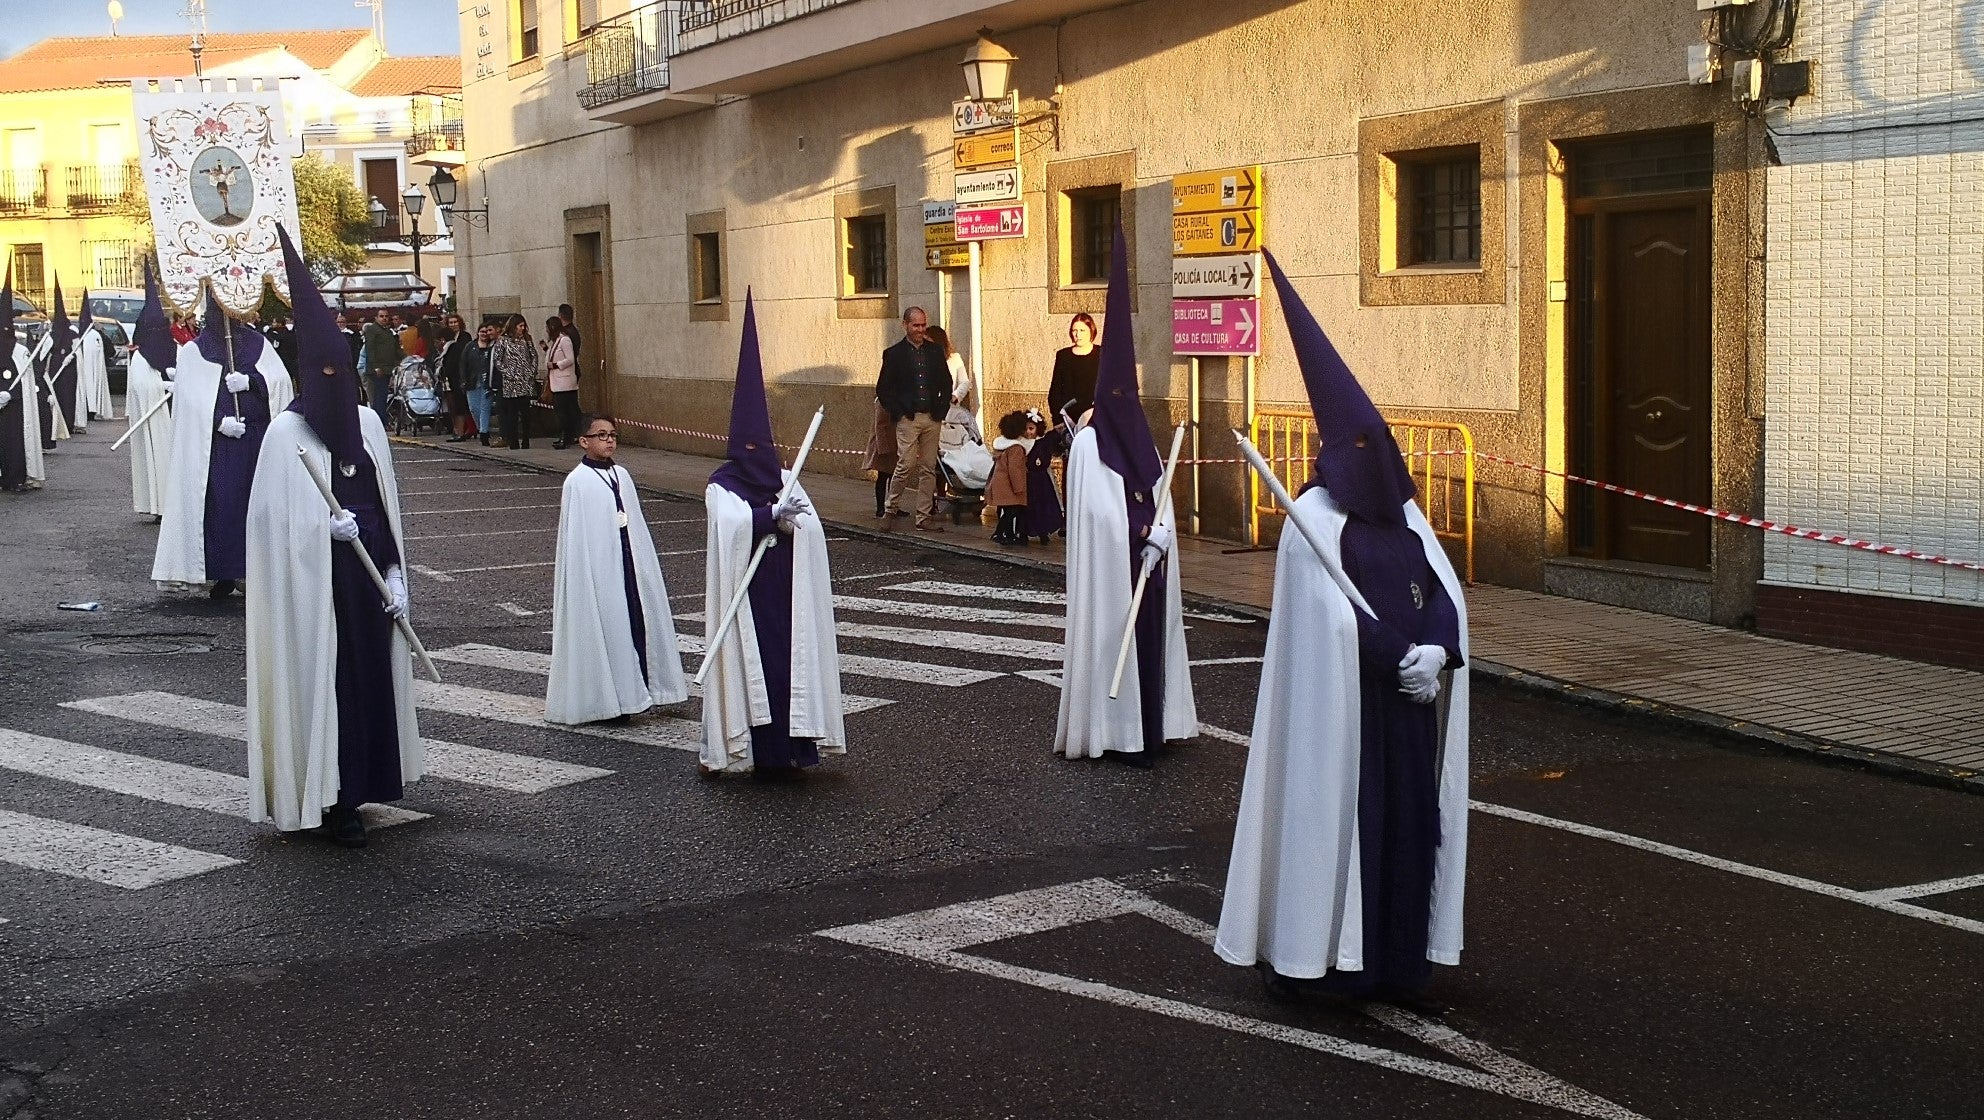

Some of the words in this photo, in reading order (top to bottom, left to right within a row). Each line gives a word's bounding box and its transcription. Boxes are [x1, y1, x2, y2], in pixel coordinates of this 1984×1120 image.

[991, 142, 1013, 153] correos
[957, 182, 995, 195] ayuntamiento
[1174, 183, 1215, 196] AYUNTAMIENTO
[925, 206, 946, 220] guardia
[975, 214, 981, 222] de
[958, 226, 968, 235] San
[971, 223, 998, 234] Bartolomé
[1174, 218, 1188, 229] CASA
[1191, 217, 1209, 228] RURAL
[1174, 230, 1184, 242] LOS
[1186, 229, 1214, 240] GAITANES
[1174, 268, 1200, 284] POLICÍA
[1203, 270, 1227, 283] LOCAL
[1174, 309, 1208, 320] BIBLIOTECA
[1174, 333, 1189, 344] CASA
[1191, 333, 1199, 343] DE
[1201, 333, 1229, 344] CULTURA
